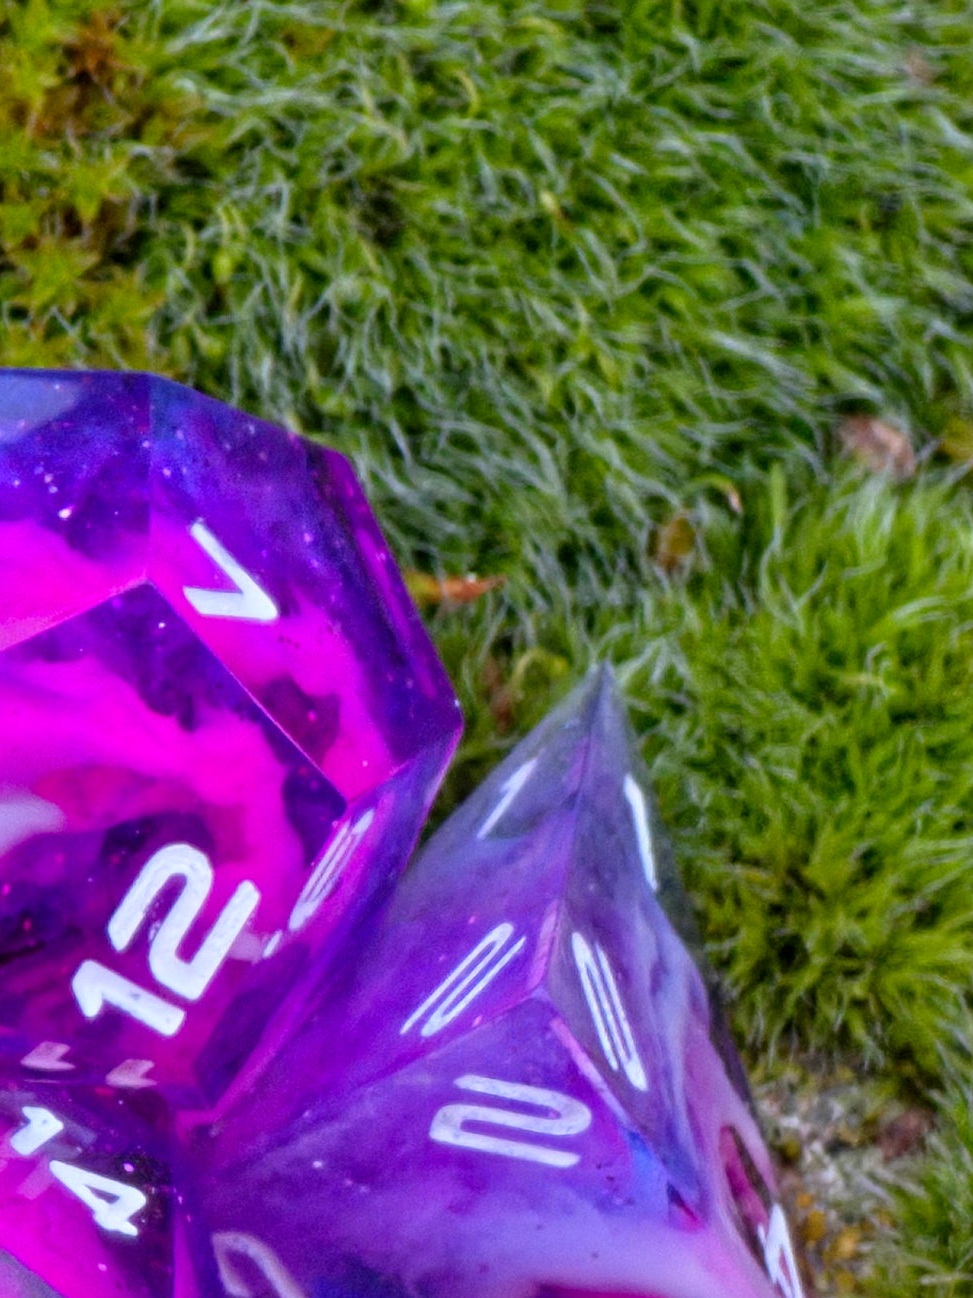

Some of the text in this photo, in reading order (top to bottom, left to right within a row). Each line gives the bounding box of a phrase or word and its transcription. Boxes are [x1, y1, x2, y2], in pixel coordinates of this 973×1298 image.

[72, 843, 259, 1036] 12
[11, 1106, 147, 1237] 14
[429, 1073, 592, 1168] 2
